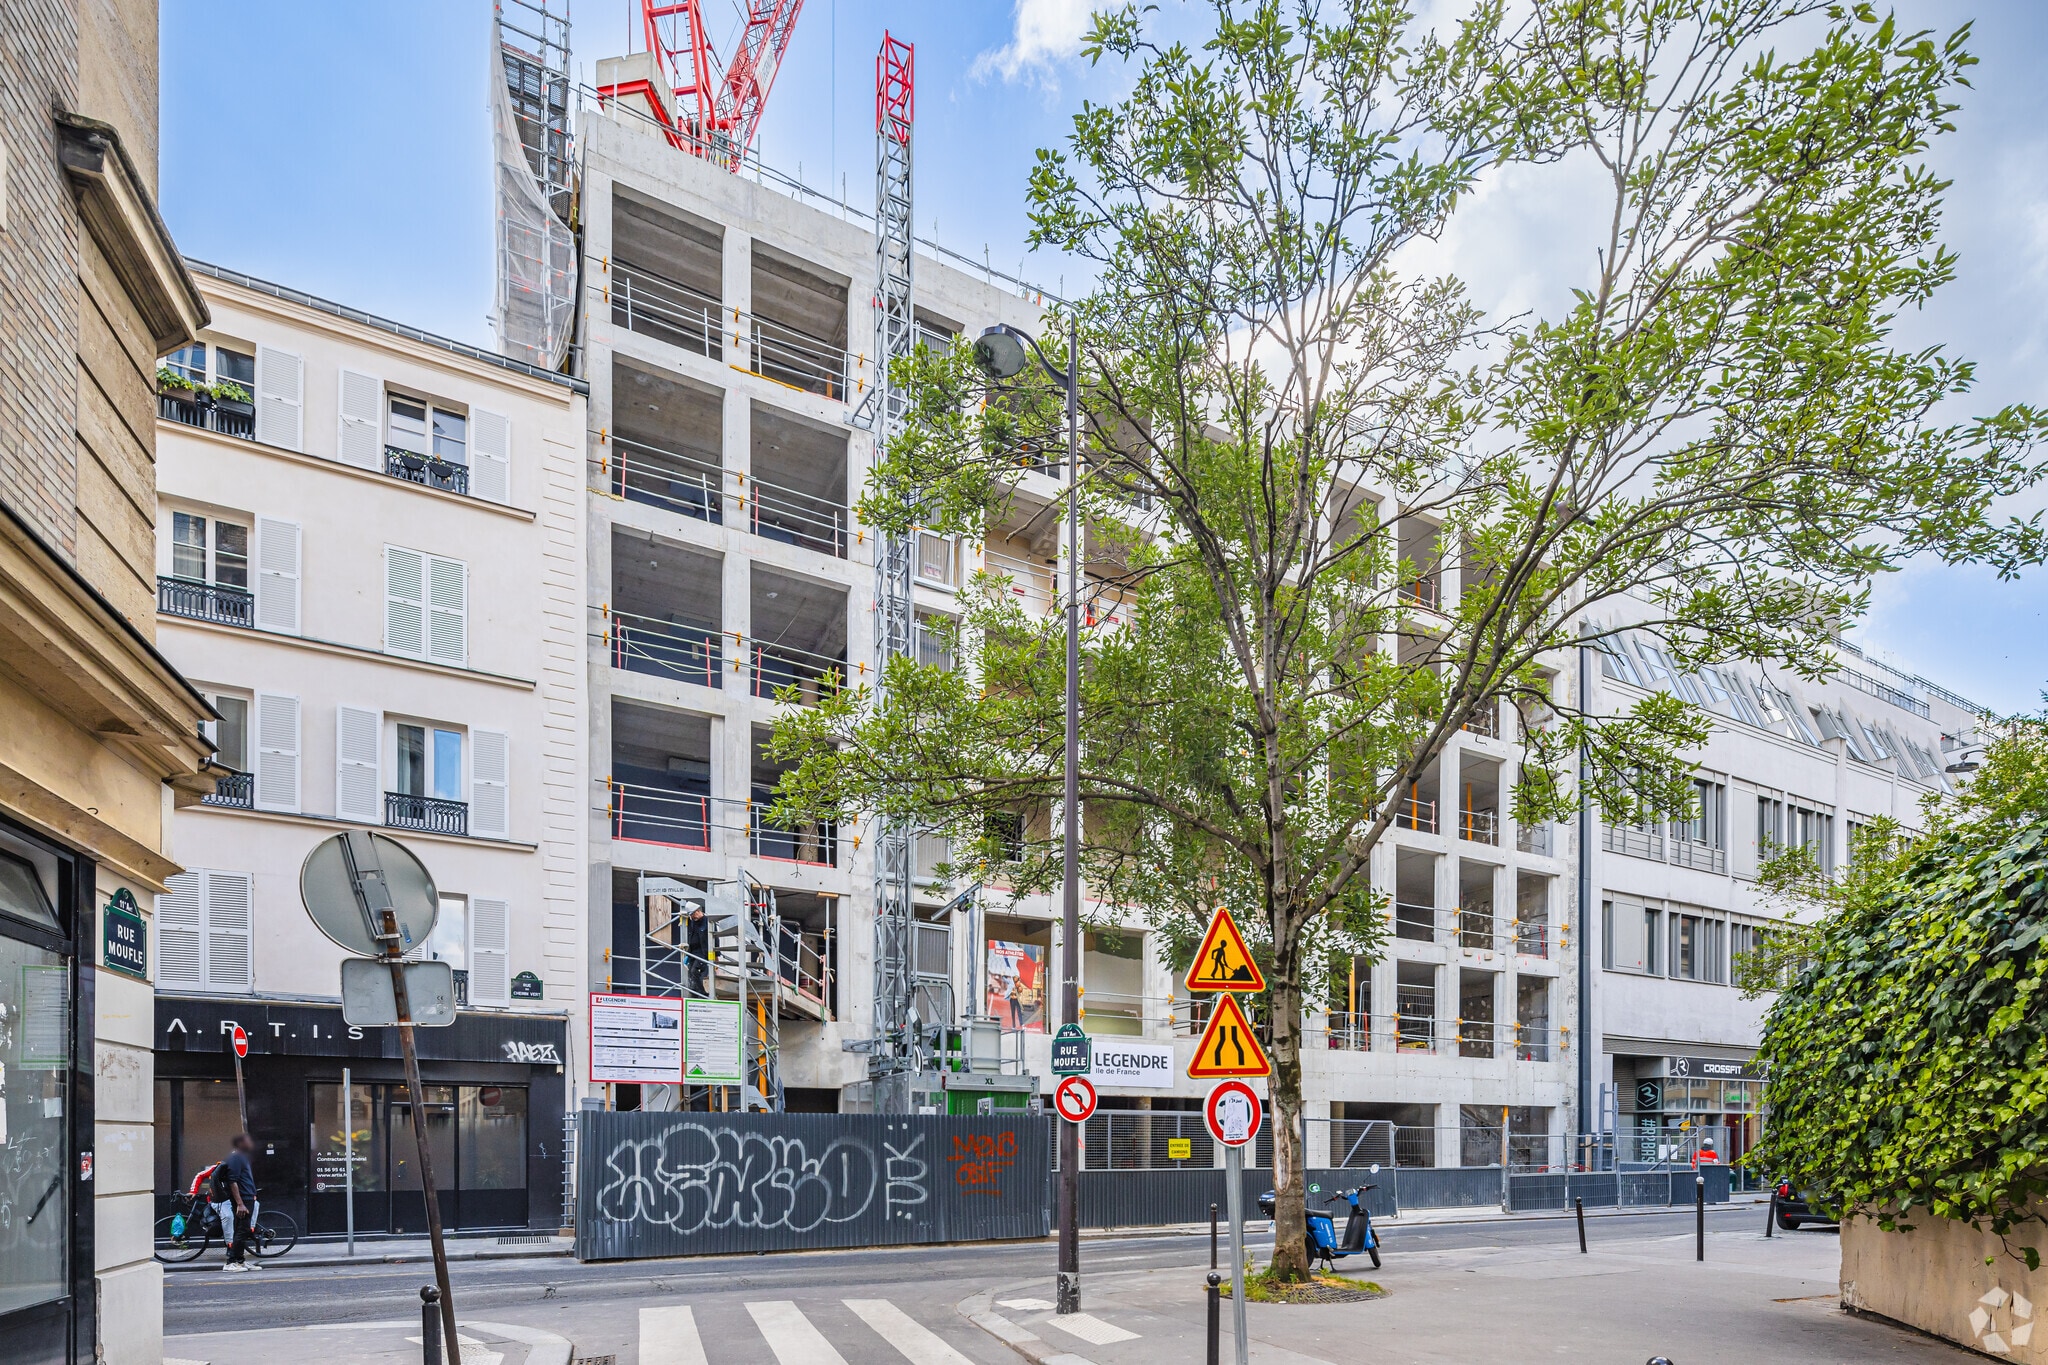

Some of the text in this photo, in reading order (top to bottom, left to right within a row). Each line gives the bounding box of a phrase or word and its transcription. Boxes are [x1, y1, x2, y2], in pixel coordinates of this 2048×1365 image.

[117, 924, 135, 943] RUE
[108, 940, 143, 965] MOUFLE
[1061, 1046, 1078, 1055] RUE
[1053, 1057, 1087, 1067] MOUFLE
[1095, 1052, 1168, 1069] LEGENDRE
[1704, 1064, 1742, 1074] CROSSFIT
